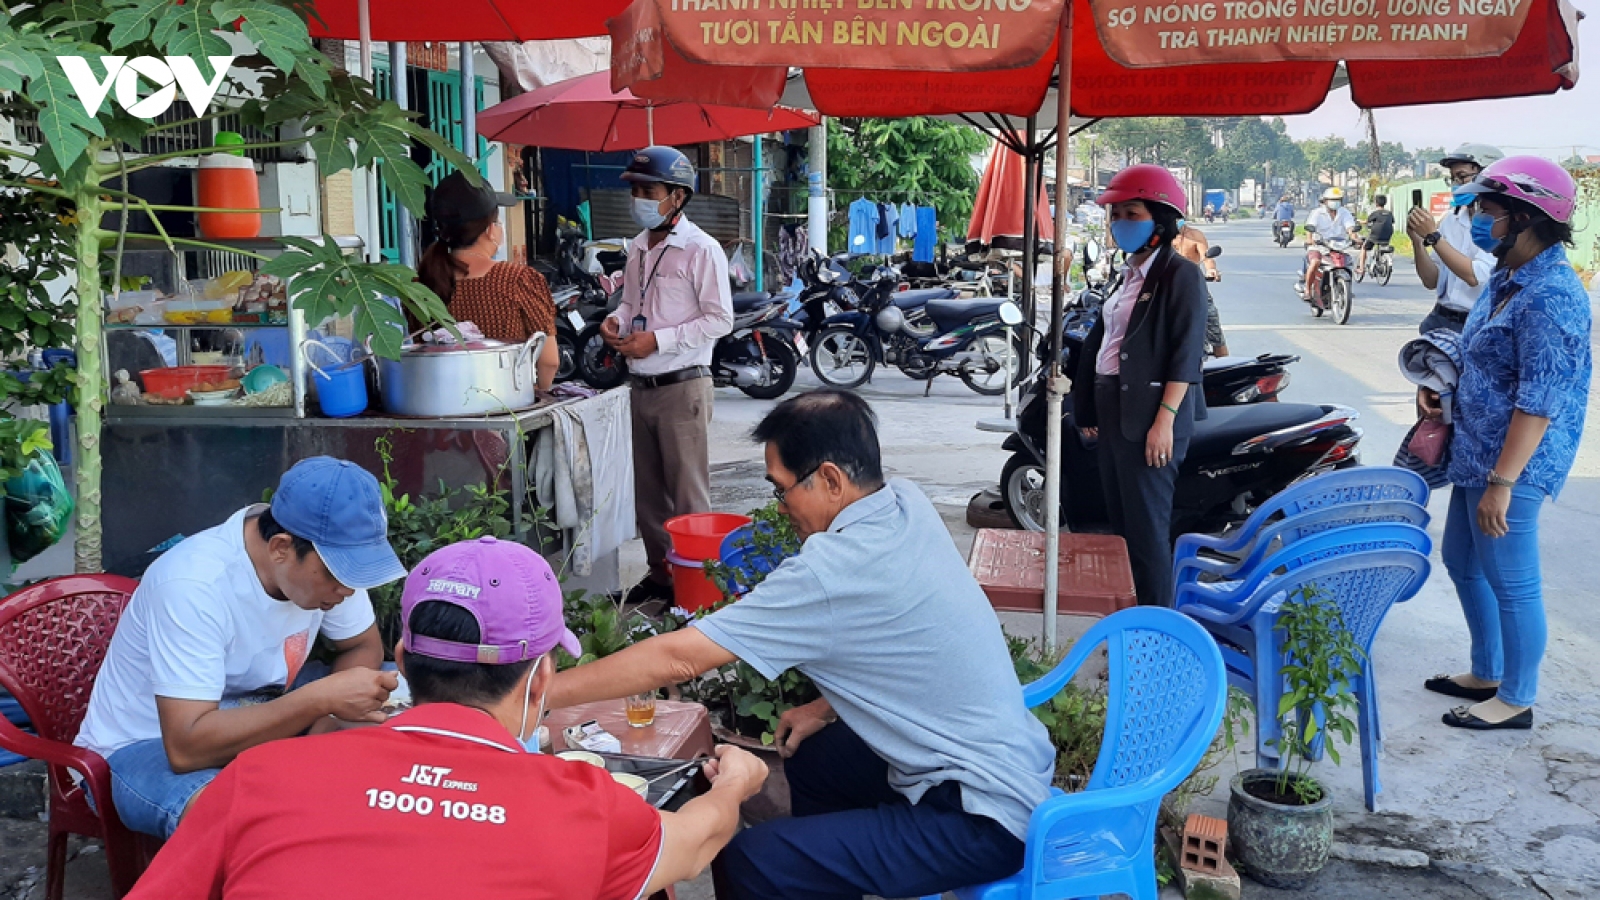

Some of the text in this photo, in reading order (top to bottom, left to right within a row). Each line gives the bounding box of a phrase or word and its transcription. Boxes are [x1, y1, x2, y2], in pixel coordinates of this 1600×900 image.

[1107, 5, 1137, 30] SỢ
[1224, 0, 1297, 19] TRONG
[1459, 0, 1520, 16] NGAY
[833, 15, 887, 46] BÊN
[896, 16, 1000, 48] NGOÀI
[1206, 26, 1281, 47] THANH
[1287, 21, 1349, 46] NHIỆT
[1351, 25, 1383, 42] DR.
[1390, 23, 1468, 42] THANH
[401, 764, 478, 791] J&T EXPRESS
[366, 788, 506, 824] 1900 1088
